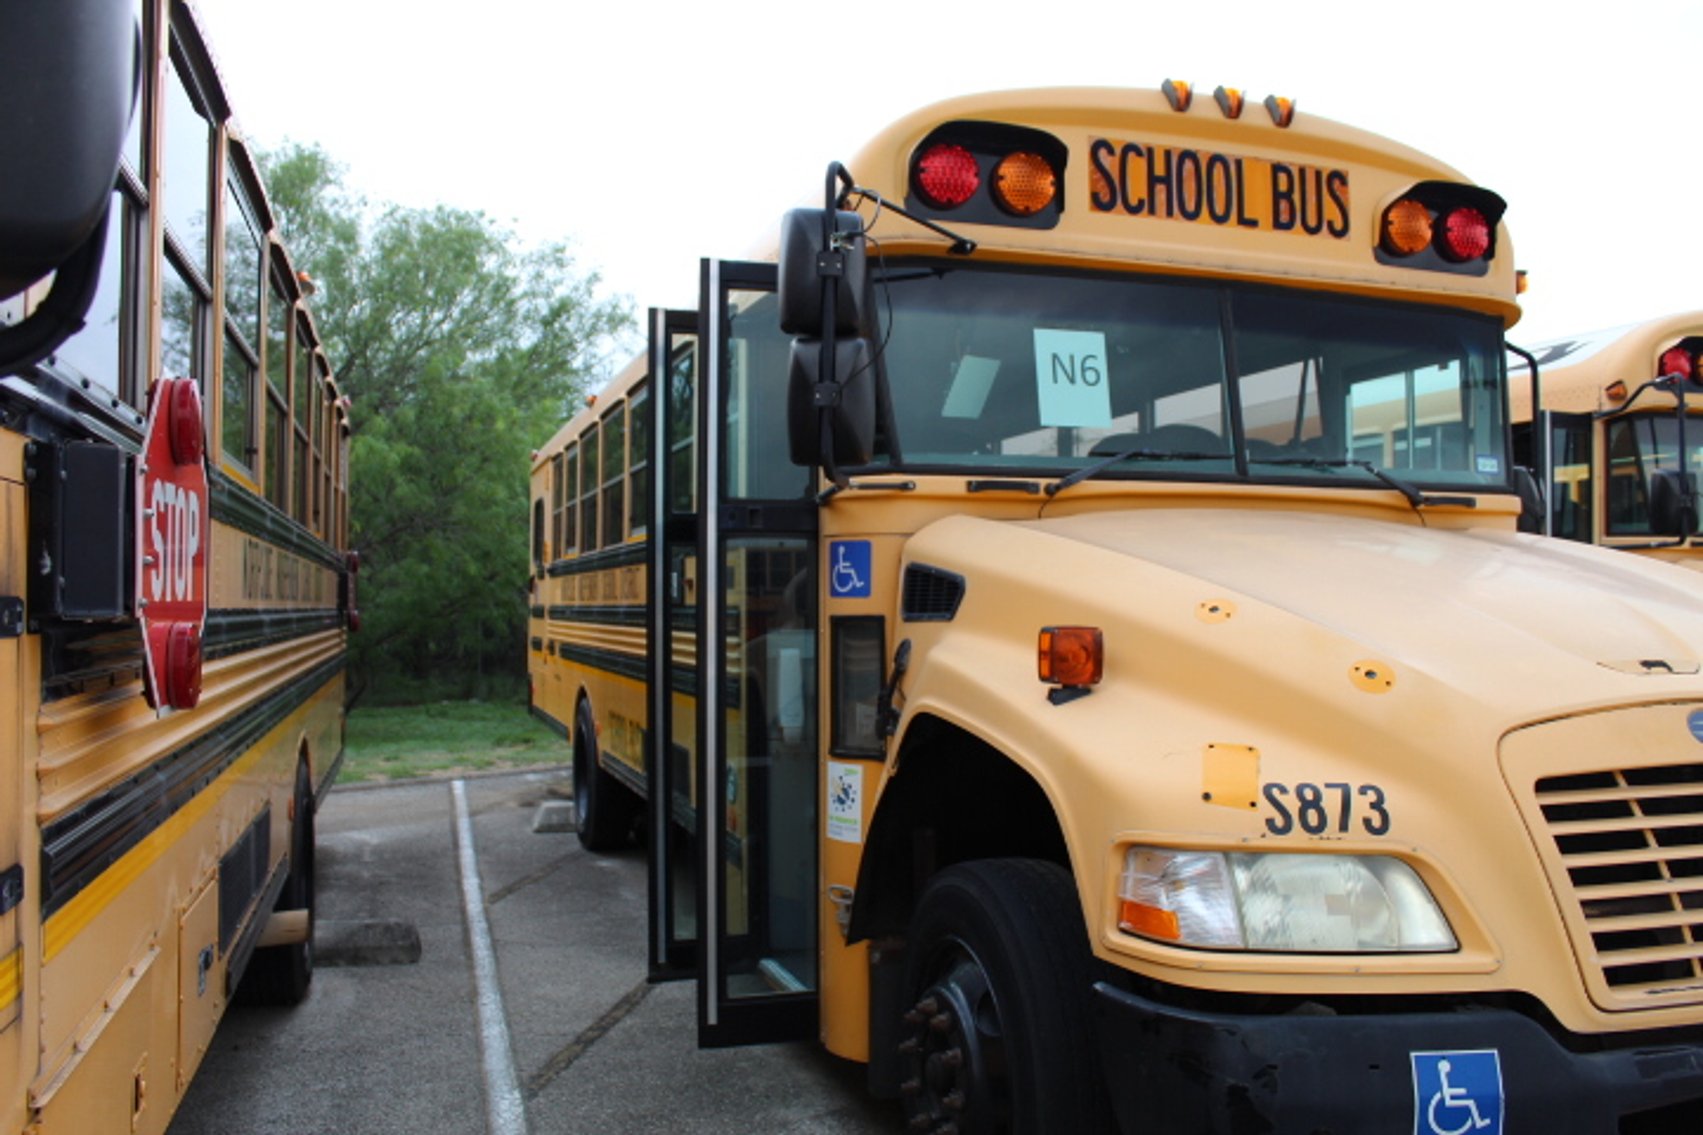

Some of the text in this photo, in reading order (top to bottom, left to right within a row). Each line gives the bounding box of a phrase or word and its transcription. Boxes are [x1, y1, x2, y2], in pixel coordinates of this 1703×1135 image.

[1089, 138, 1350, 239] SCHOOL BUS
[1051, 352, 1101, 387] N6
[150, 478, 200, 602] STOP
[1262, 782, 1391, 836] S873
